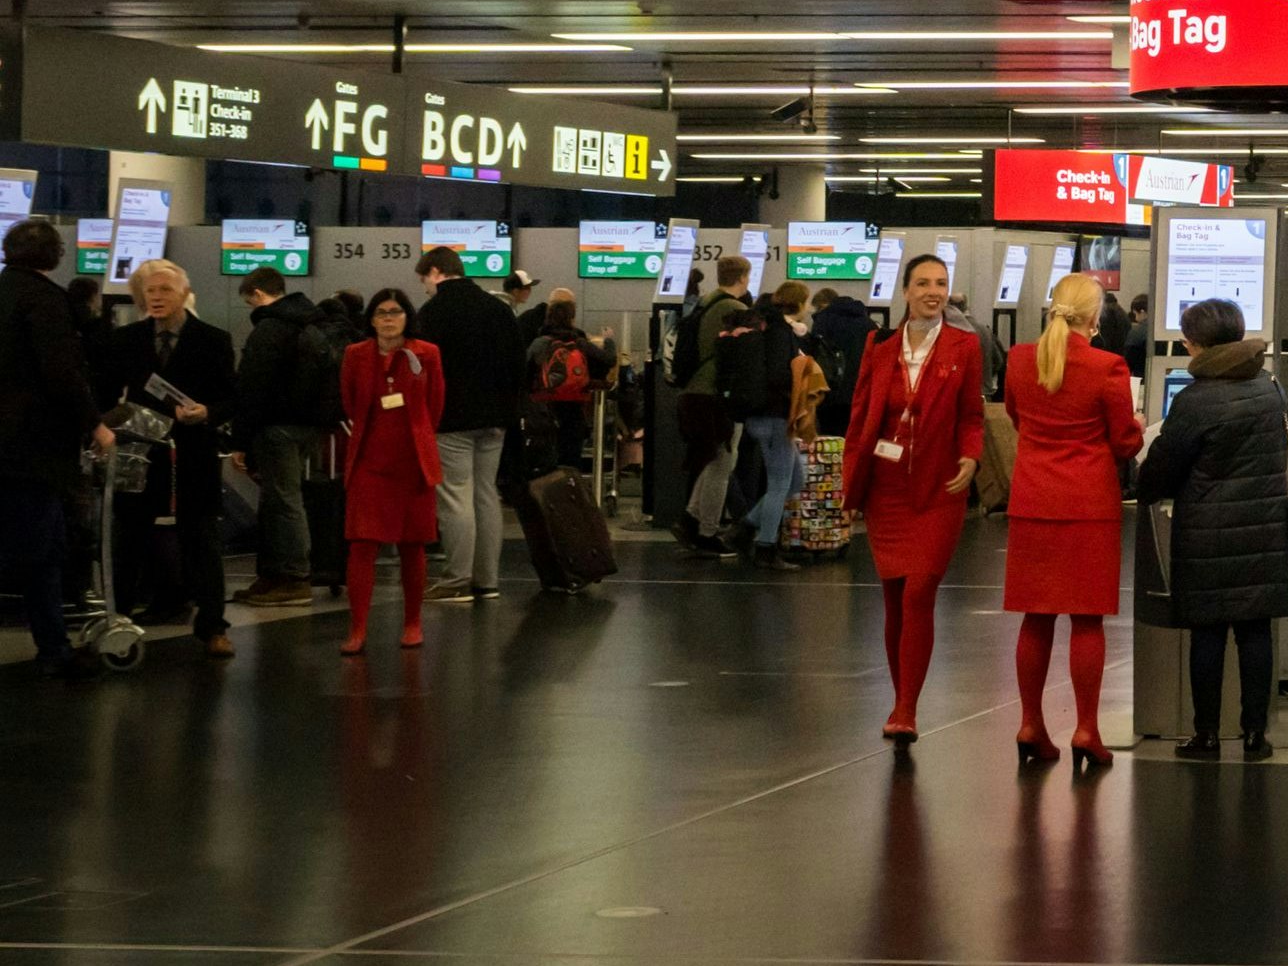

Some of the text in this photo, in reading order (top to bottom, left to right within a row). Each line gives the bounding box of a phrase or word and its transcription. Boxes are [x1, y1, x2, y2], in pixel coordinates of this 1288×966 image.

[1168, 8, 1227, 53] Tag
[210, 84, 260, 104] Terminal 3
[336, 81, 358, 95] Gates
[424, 92, 446, 105] Gates
[210, 103, 251, 121] Check-in
[1118, 156, 1125, 179] 1
[1056, 169, 1111, 184] Check-in
[1145, 168, 1186, 191] Austrian
[1220, 168, 1228, 190] 1
[1056, 187, 1115, 204] & Bag Tag
[799, 227, 838, 236] Austrian
[334, 243, 365, 260] 354
[381, 243, 411, 260] 353
